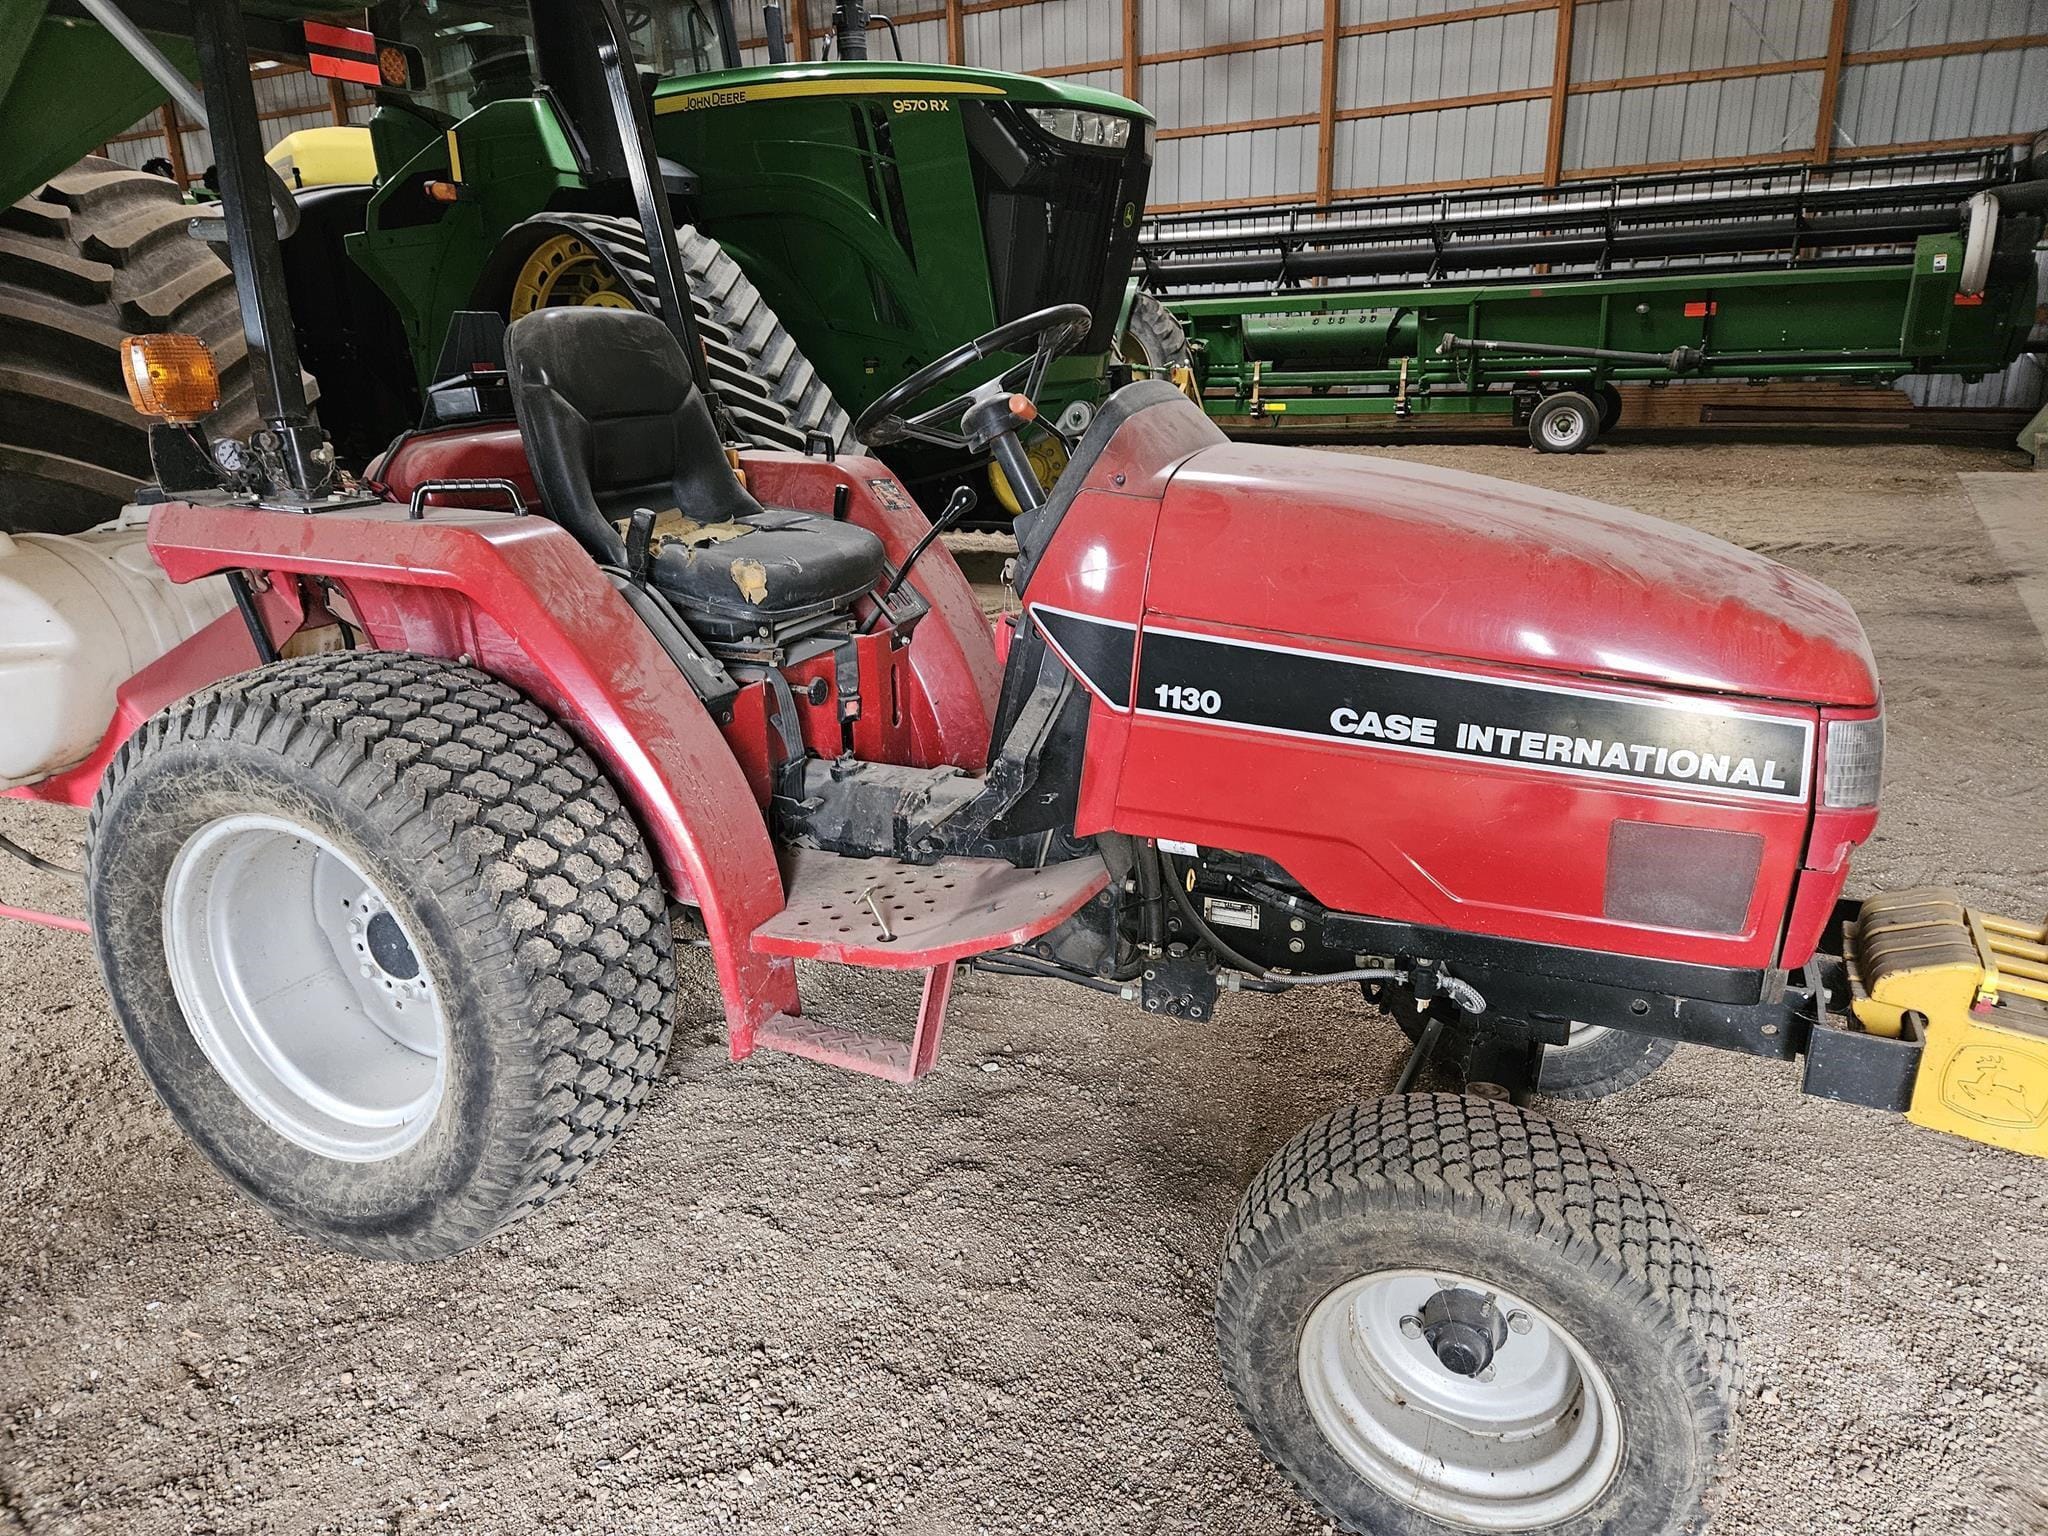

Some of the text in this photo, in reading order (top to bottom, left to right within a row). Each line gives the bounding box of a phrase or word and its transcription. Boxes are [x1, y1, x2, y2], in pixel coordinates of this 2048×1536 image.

[684, 91, 746, 111] JOHN DEERE
[892, 99, 950, 113] 9570 RX
[1154, 684, 1222, 714] 1130
[1330, 707, 1786, 789] CASE INTERNATIONAL
